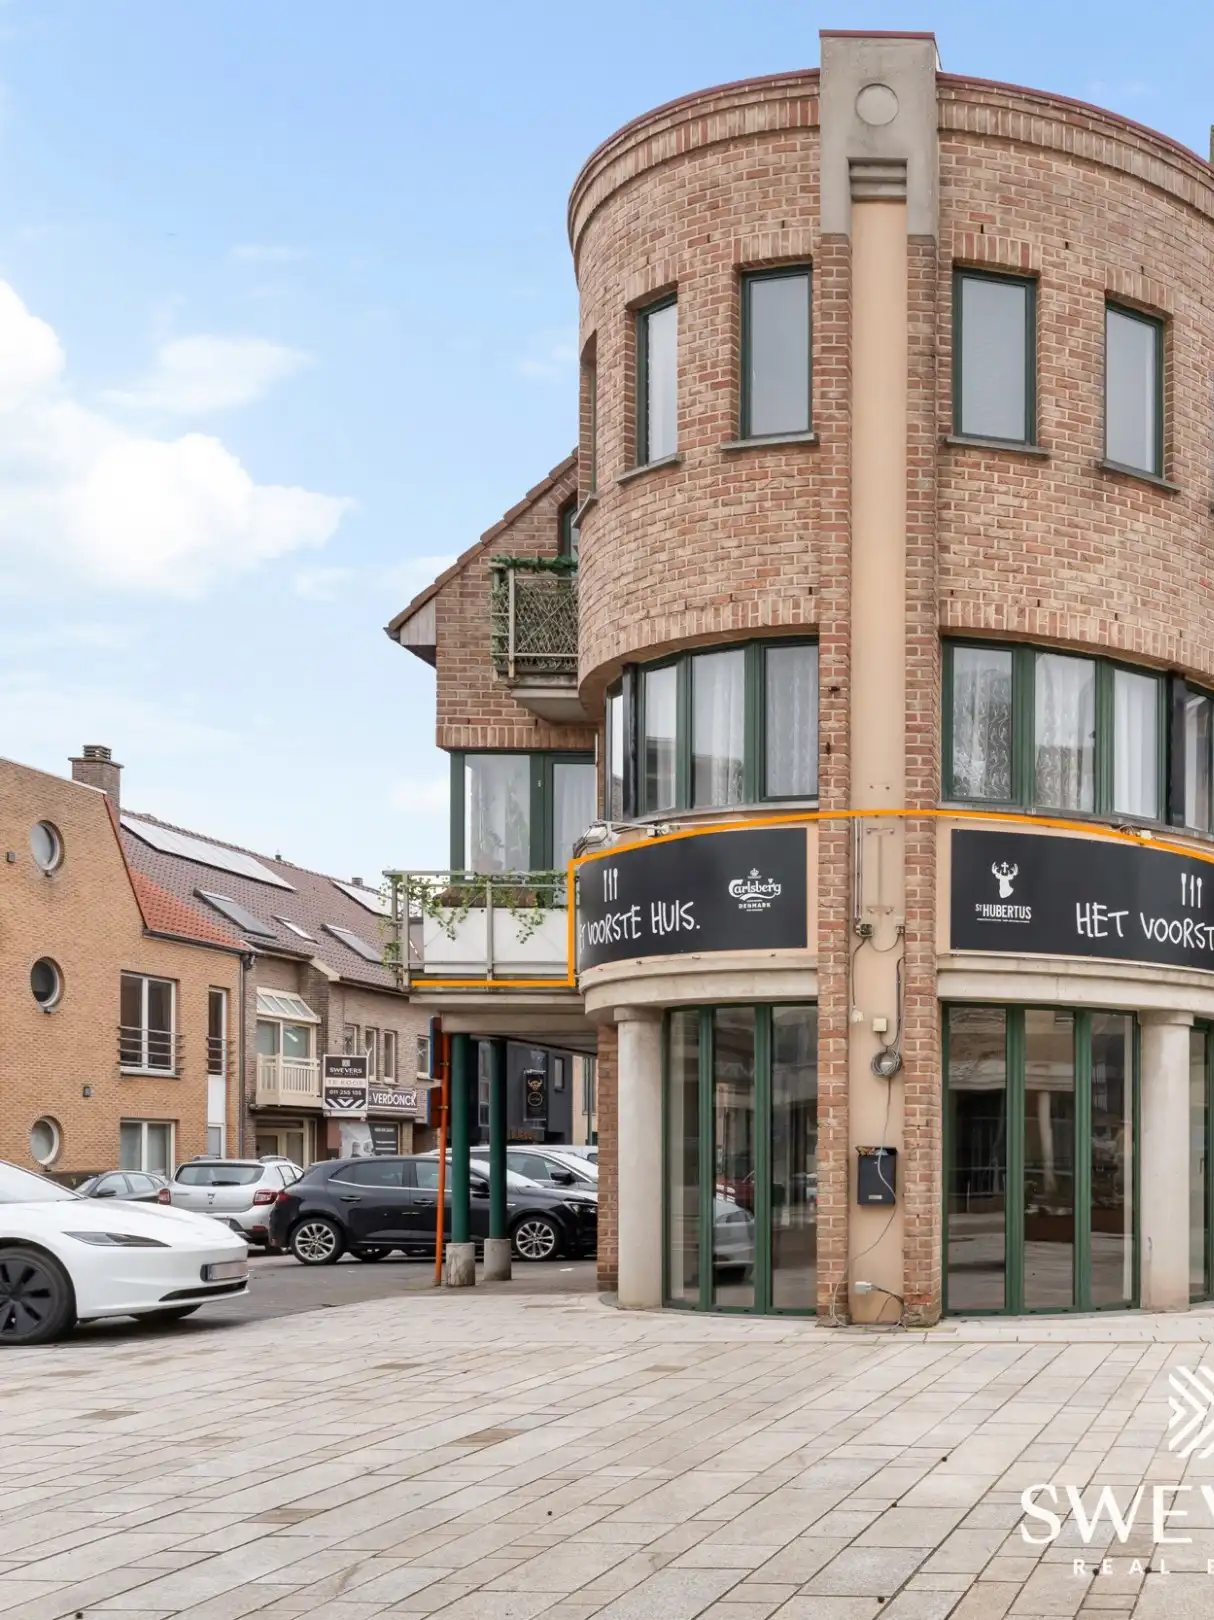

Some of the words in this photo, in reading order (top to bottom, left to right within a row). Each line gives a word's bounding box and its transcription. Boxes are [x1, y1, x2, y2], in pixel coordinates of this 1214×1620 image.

[728, 878, 781, 900] Carlsberg
[982, 904, 1032, 919] HUBERTUS
[1076, 902, 1129, 938] HET
[588, 904, 642, 946] VOORSTE
[651, 900, 701, 935] HUIS.
[372, 1092, 417, 1106] VERDONCK
